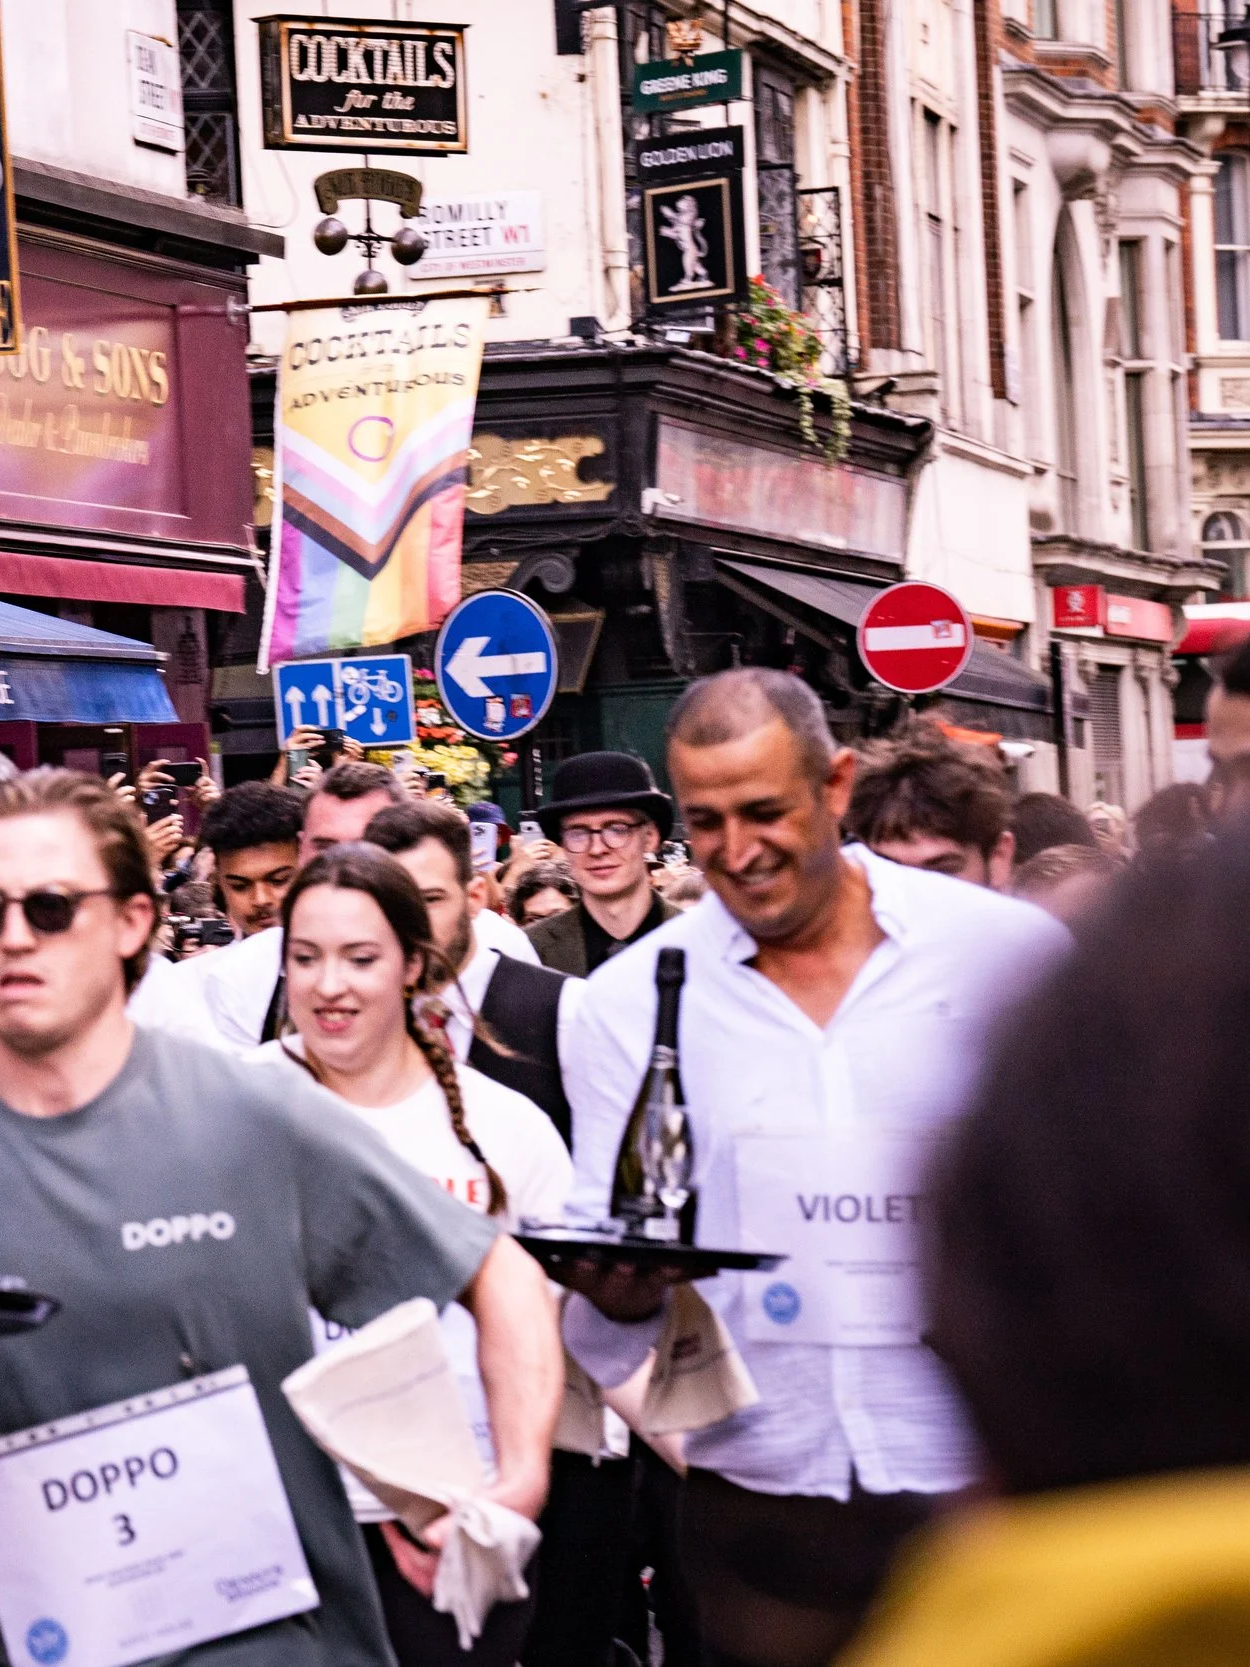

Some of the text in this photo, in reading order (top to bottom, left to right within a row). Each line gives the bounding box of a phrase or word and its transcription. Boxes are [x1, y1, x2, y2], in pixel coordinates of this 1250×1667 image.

[290, 34, 455, 88] COCKTAILS
[639, 74, 692, 95] GREENE
[692, 69, 728, 88] KING
[334, 89, 415, 112] for the
[294, 114, 457, 134] ADVENTUROUS
[640, 141, 734, 167] GOLDEN LION
[501, 225, 529, 244] W1
[290, 323, 470, 370] COCKTAILS
[62, 333, 86, 389] &
[94, 339, 169, 405] SONS
[290, 373, 466, 410] ADVENTUROUS
[121, 1211, 236, 1251] DOPPO
[42, 1446, 178, 1513] DOPPO
[113, 1513, 136, 1547] 3
